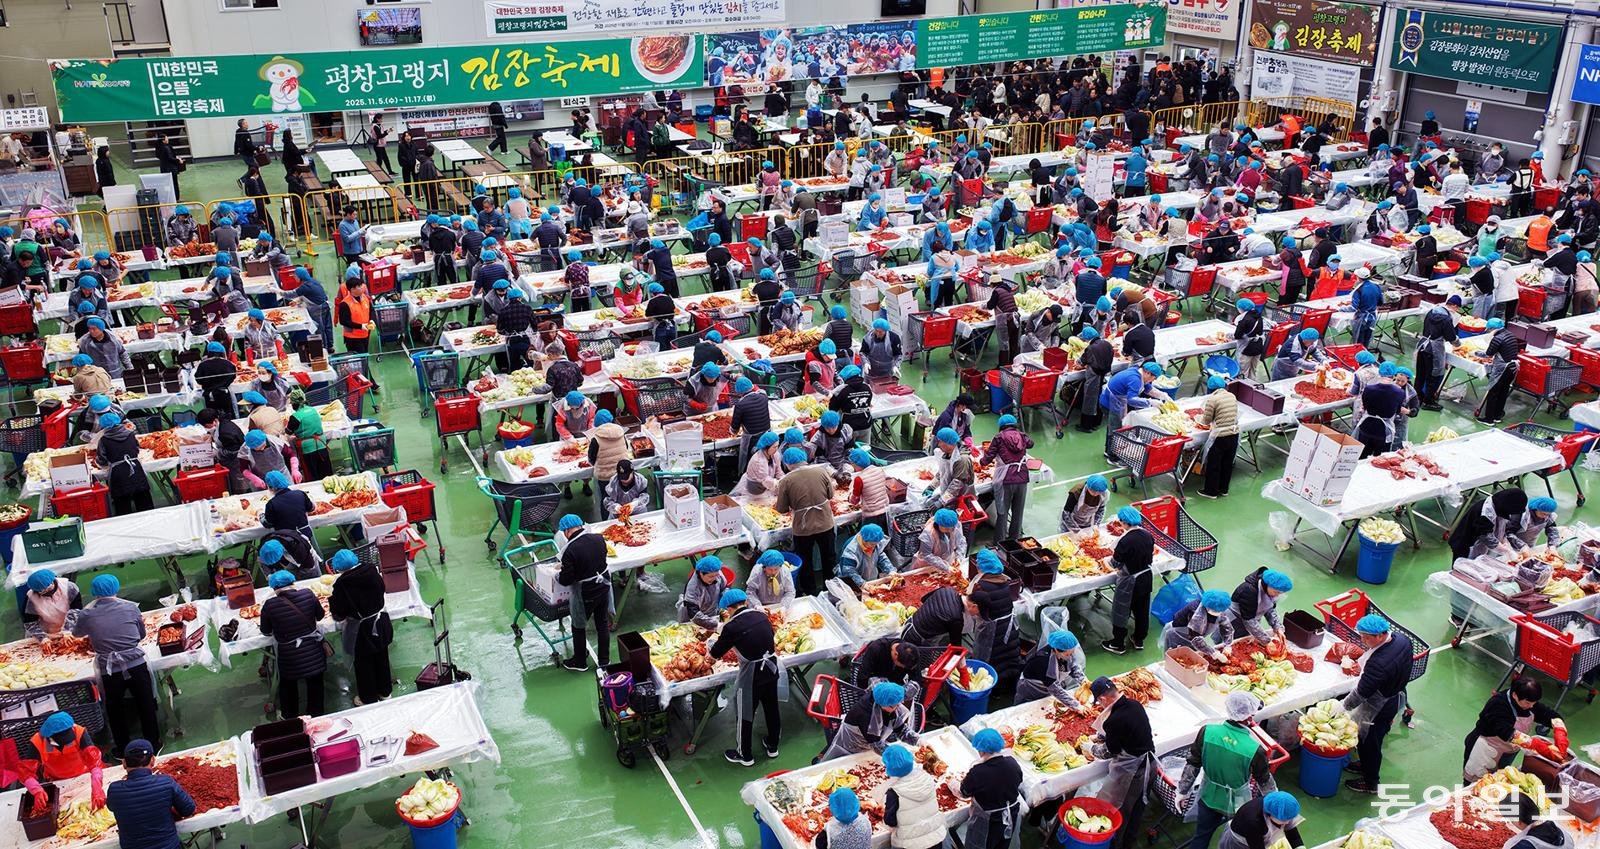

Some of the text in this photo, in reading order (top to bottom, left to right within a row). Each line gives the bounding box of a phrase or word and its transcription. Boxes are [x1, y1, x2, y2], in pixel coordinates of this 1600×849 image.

[496, 8, 522, 16] 대한민국
[538, 6, 564, 14] 김장축제
[572, 9, 602, 20] 건강한
[606, 8, 630, 18] 재료로
[632, 6, 668, 16] 간편하고
[670, 2, 695, 18] 즐겁게
[699, 4, 724, 15] 맛있는
[1029, 13, 1059, 23] 간편합니다
[1078, 9, 1107, 20] 즐겁습니다
[928, 20, 959, 31] 건강합니다
[979, 17, 1008, 27] 맛있습니다
[1313, 12, 1347, 25] 평창고랭지
[1295, 24, 1362, 54] 김장축제
[1441, 22, 1540, 45] 11월 11일은 김장의 날
[1429, 40, 1510, 61] 김장문화와 김치산업을
[154, 60, 218, 77] 대한민국
[324, 46, 620, 93] 평창고랭지 김장축제
[1452, 60, 1540, 81] 평창 발전의 원동력으로!
[157, 81, 189, 96] 으뜸
[404, 94, 436, 103] 11.17.(월)
[563, 97, 587, 107] 퇴식구
[161, 98, 225, 116] 김장축제
[448, 106, 488, 116] 안전관리책임
